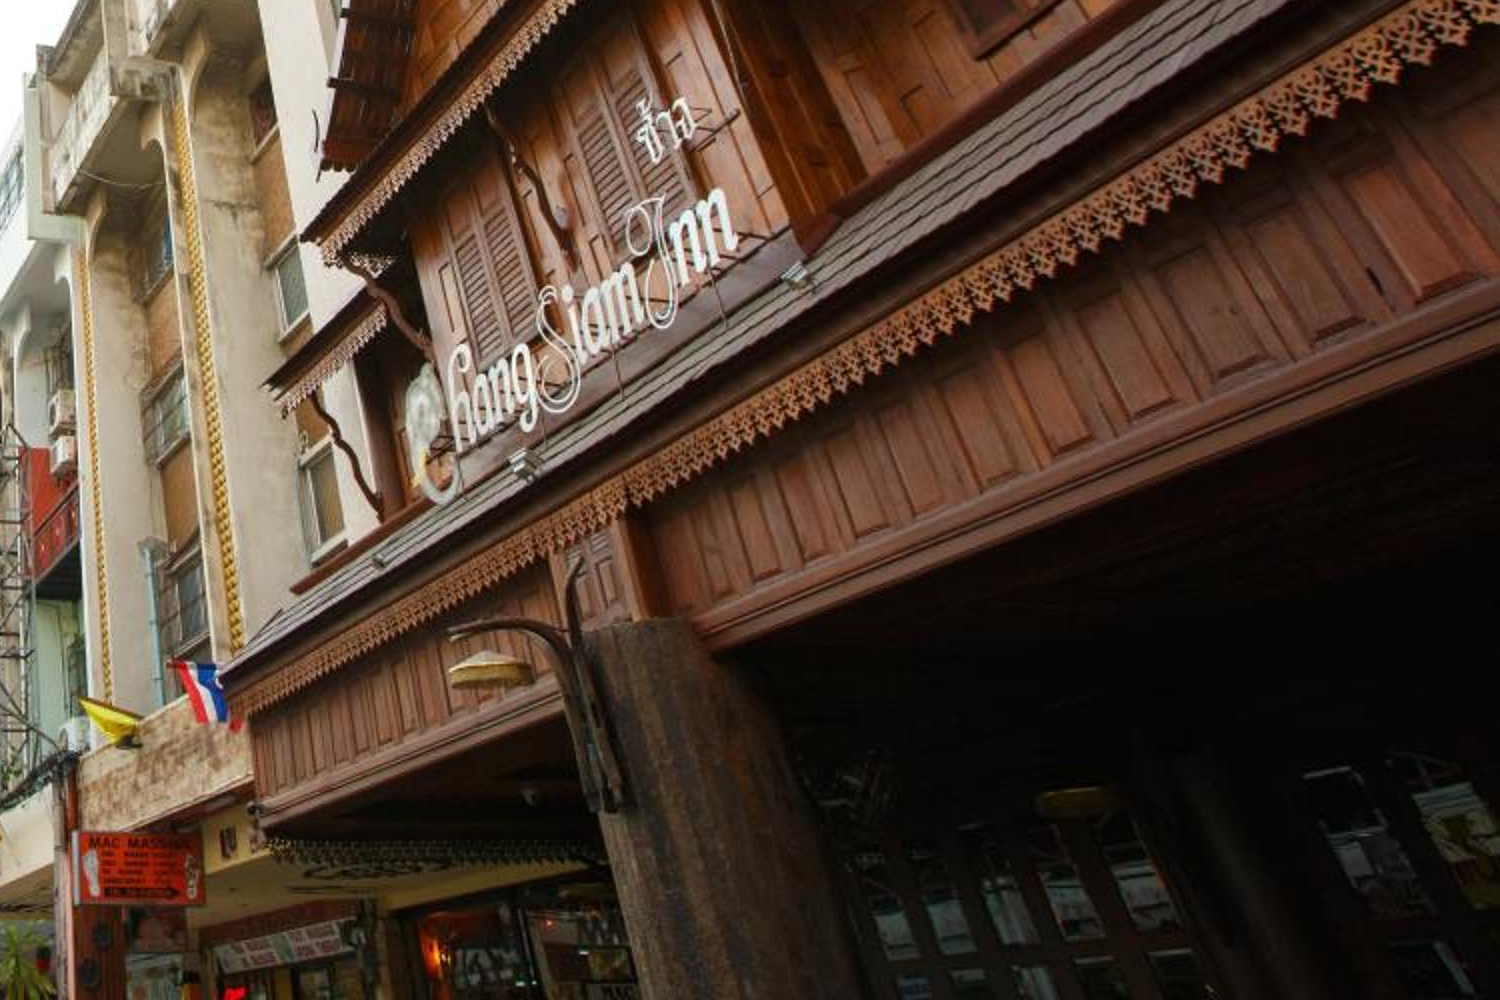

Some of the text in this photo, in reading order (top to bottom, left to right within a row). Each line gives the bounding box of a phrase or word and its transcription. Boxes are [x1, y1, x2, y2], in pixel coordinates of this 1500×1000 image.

[636, 93, 696, 163] ช้าง
[536, 262, 645, 414] Siam
[626, 187, 739, 329] Inn
